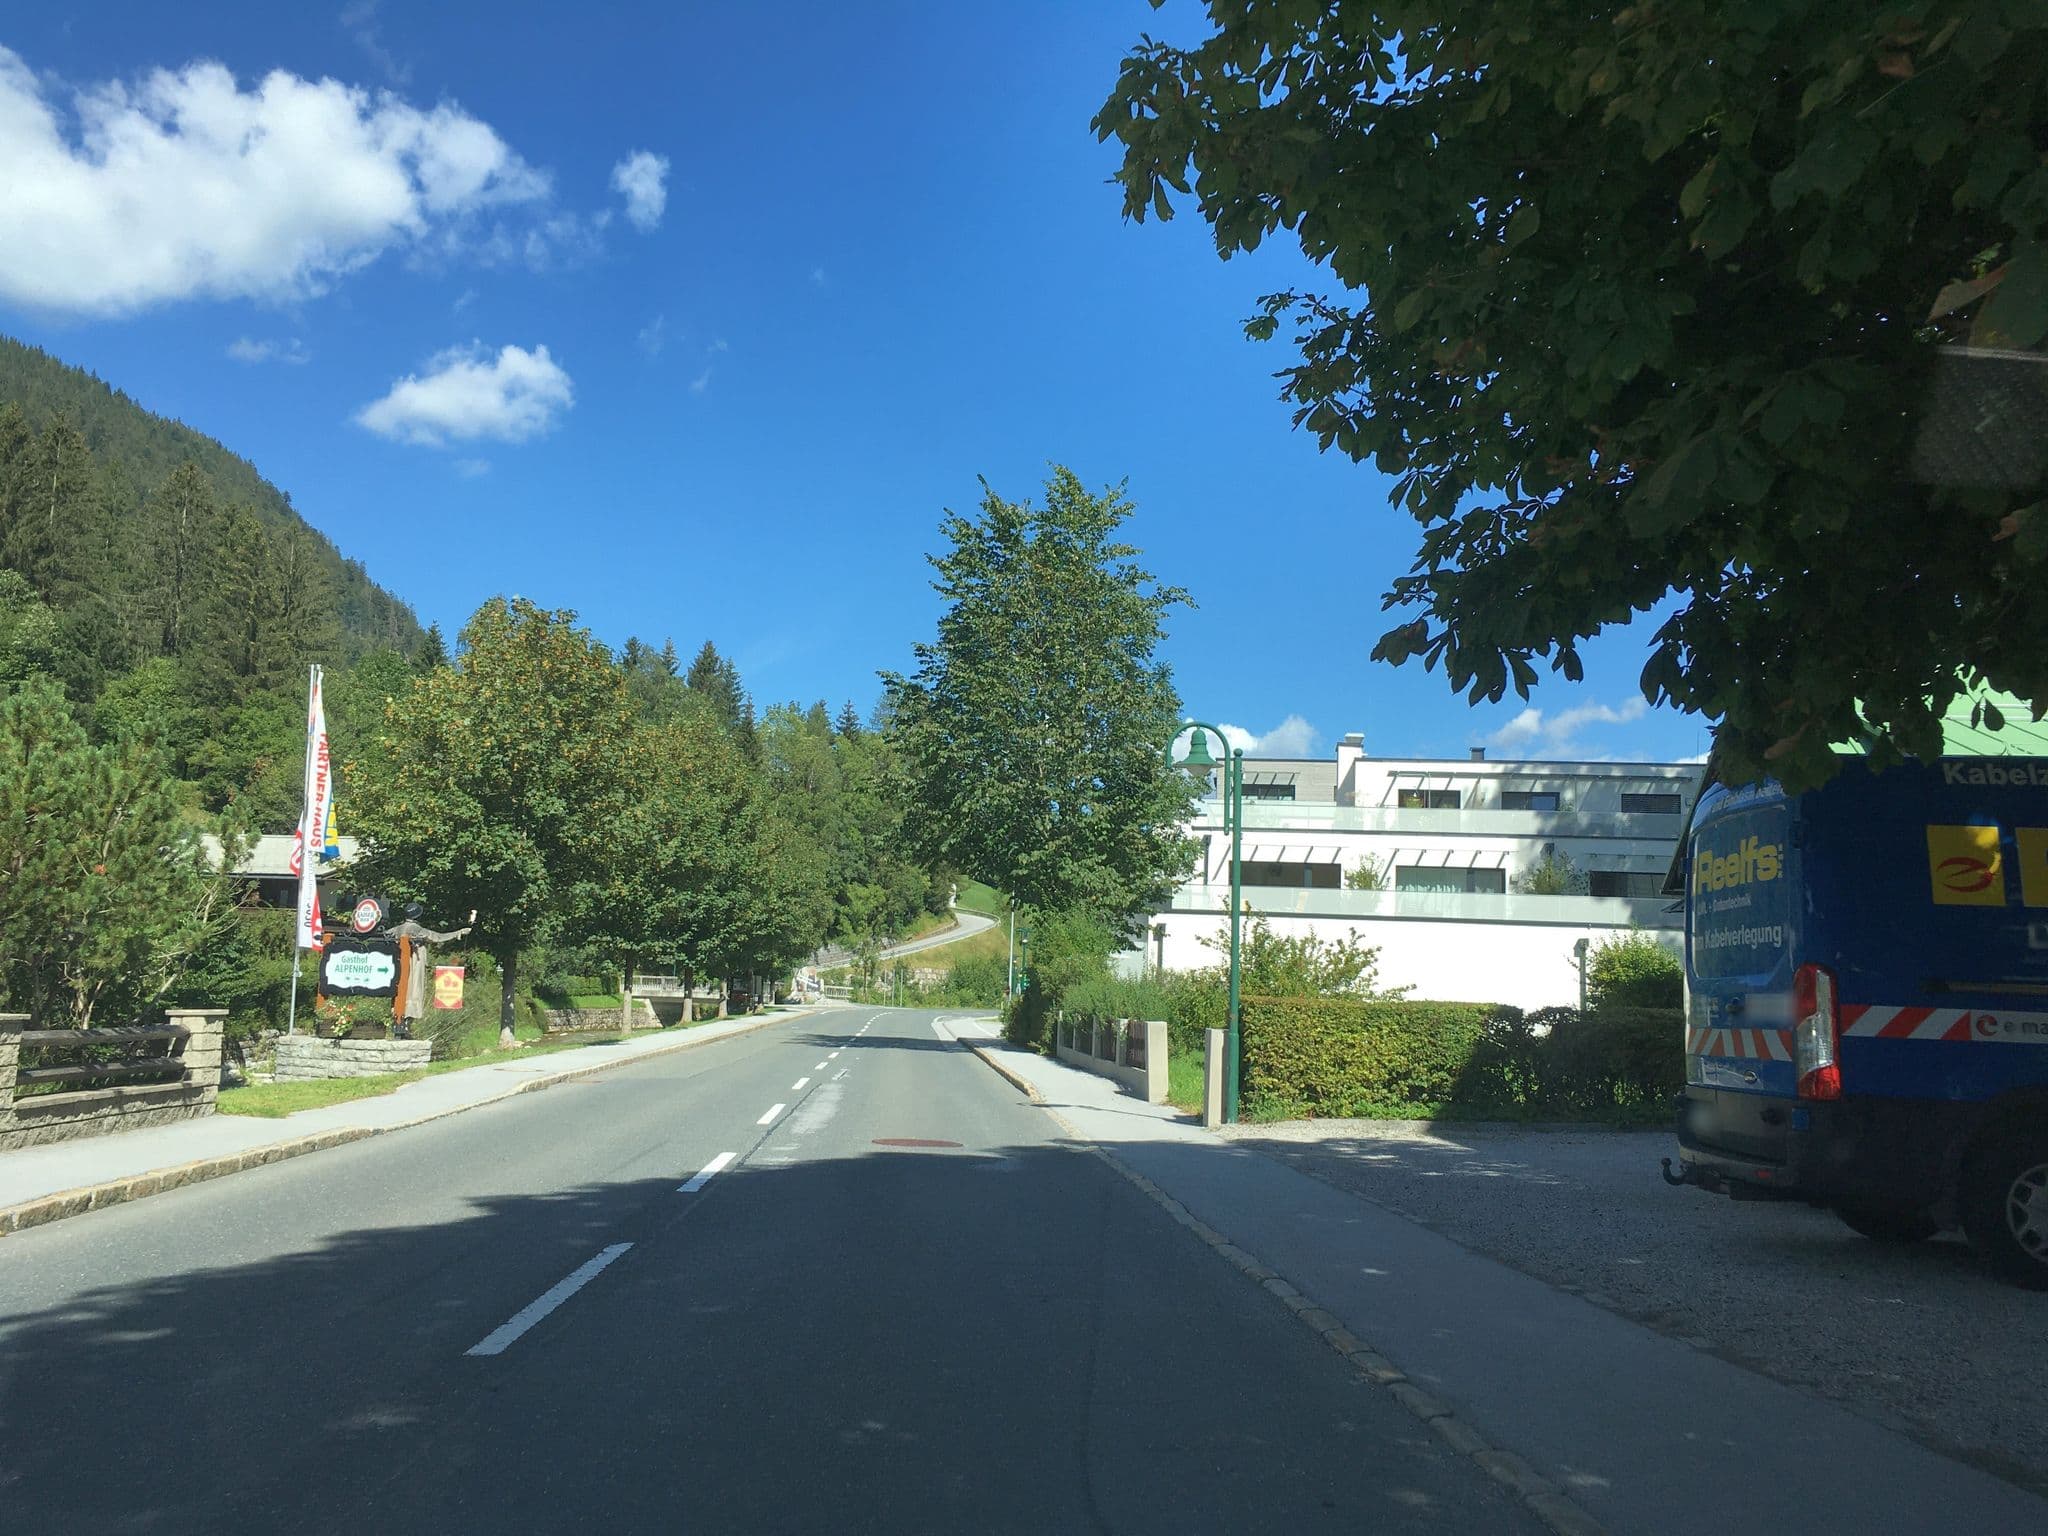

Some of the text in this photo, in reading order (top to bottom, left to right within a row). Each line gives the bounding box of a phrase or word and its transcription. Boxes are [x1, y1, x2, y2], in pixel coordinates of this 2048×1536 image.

[310, 733, 331, 848] PARTNER-HAUS
[1704, 924, 1782, 949] Kabelverlegung
[341, 954, 368, 964] Gasthof
[334, 964, 374, 974] ALPENHOF
